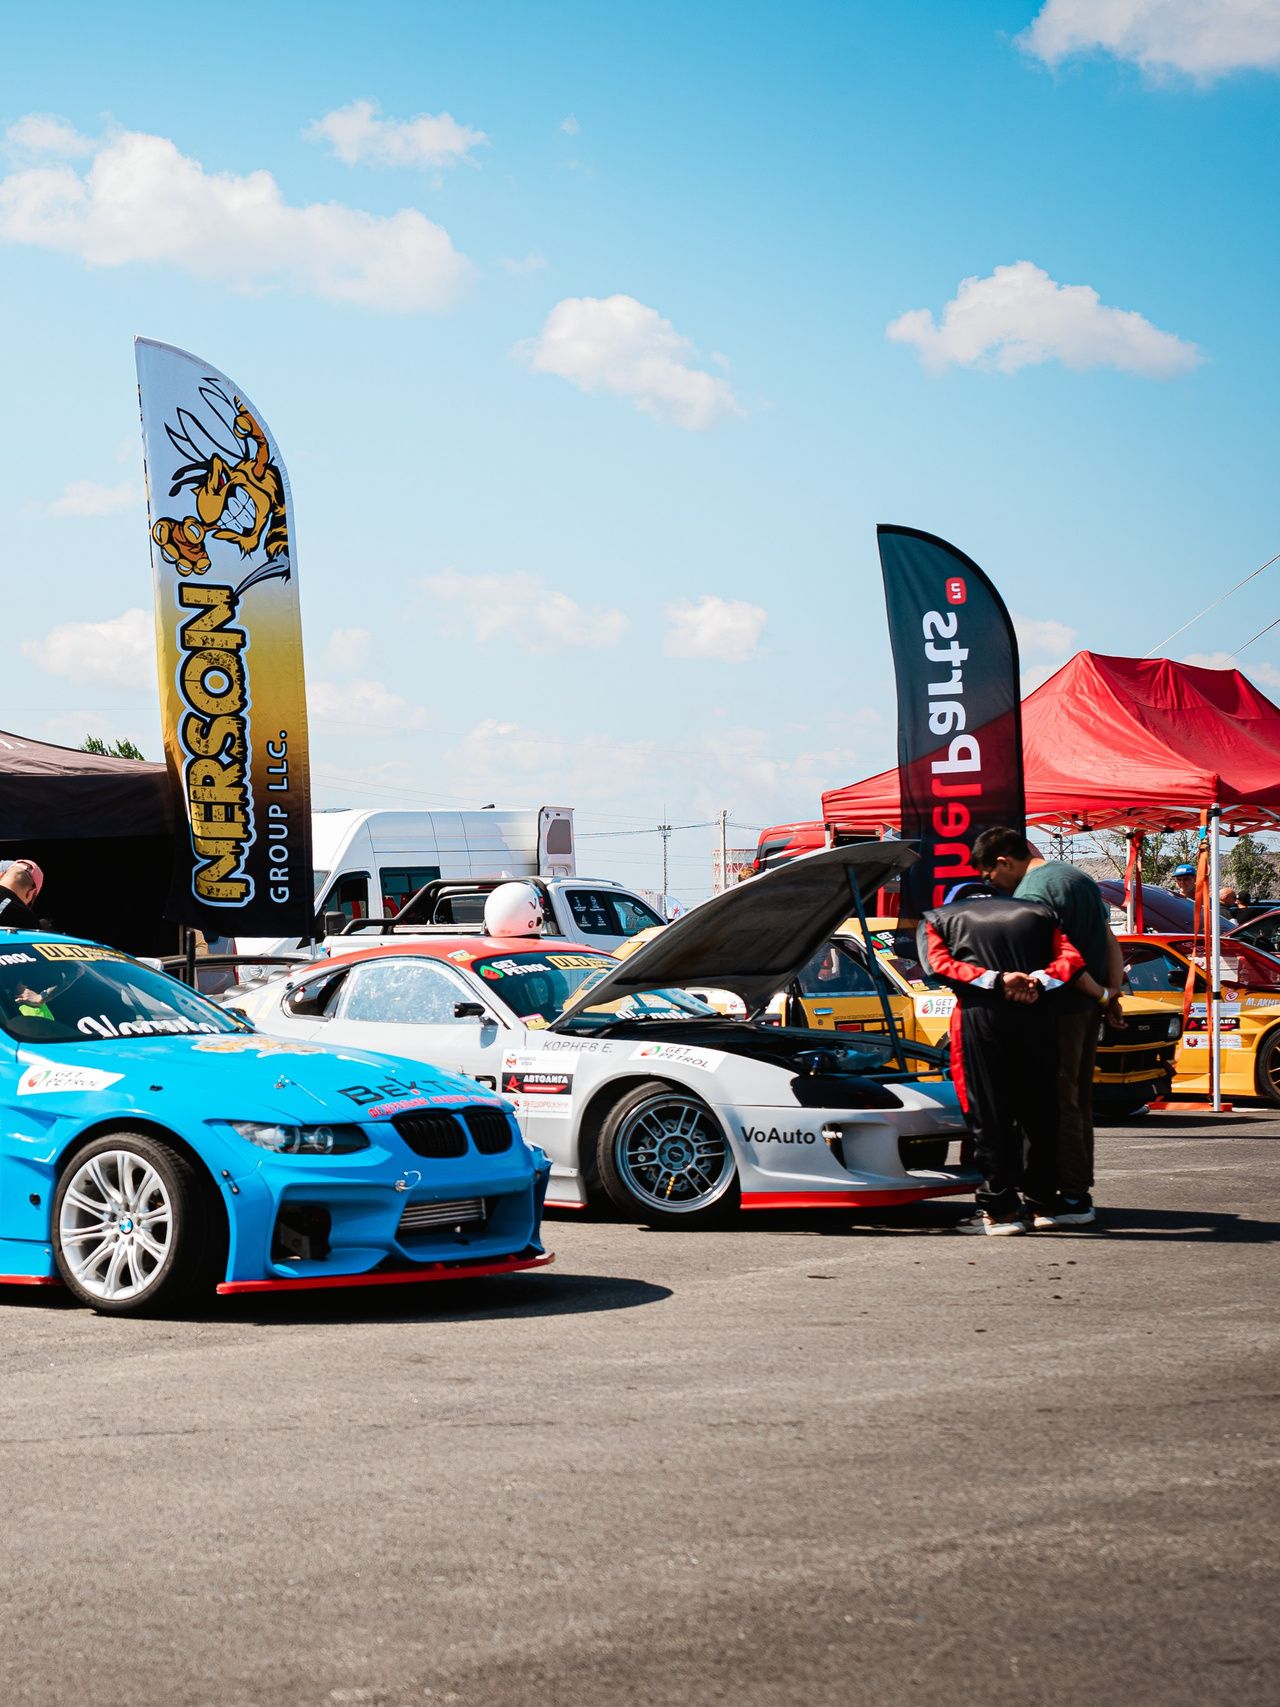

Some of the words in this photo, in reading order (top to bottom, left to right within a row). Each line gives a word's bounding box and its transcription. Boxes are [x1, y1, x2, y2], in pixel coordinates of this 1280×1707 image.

[180, 584, 249, 902] NERSON
[268, 729, 289, 792] LLC.
[269, 803, 291, 903] GROUP
[491, 959, 518, 970] GET
[502, 963, 552, 976] PETROL
[935, 1007, 951, 1015] PET
[665, 1046, 690, 1056] GET
[658, 1053, 708, 1068] PETROL
[741, 1125, 816, 1146] VoAuto
